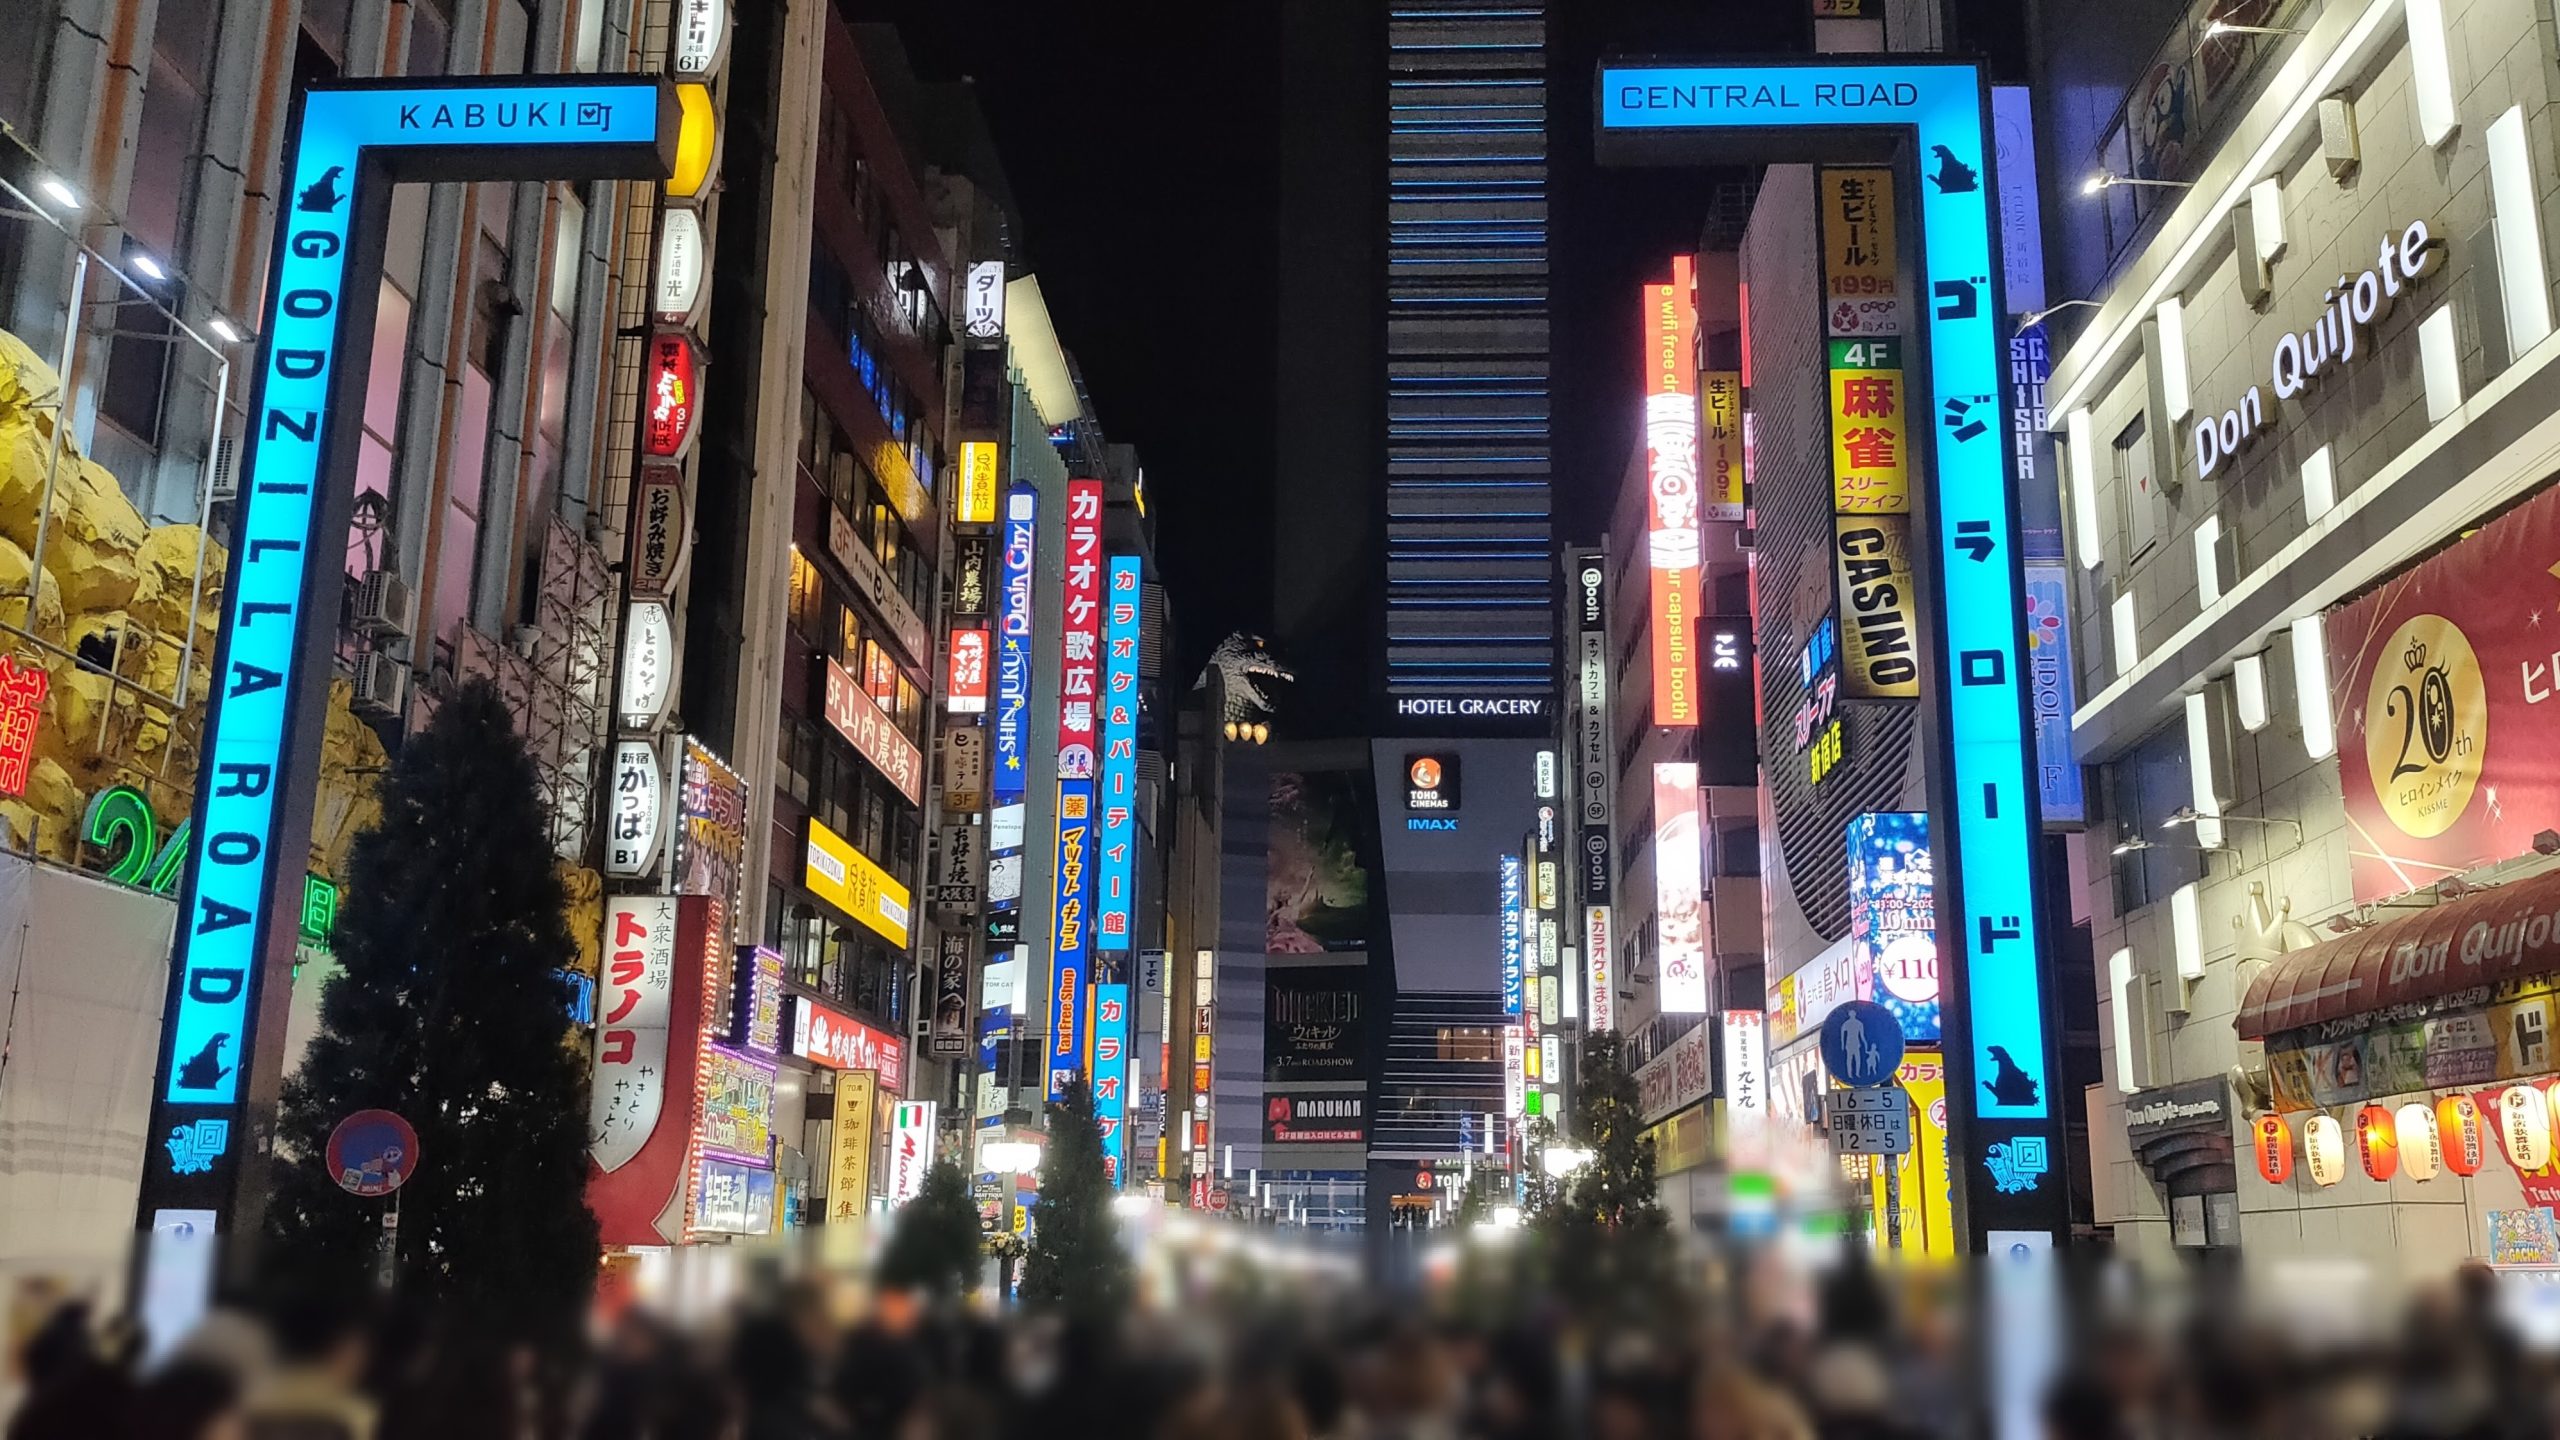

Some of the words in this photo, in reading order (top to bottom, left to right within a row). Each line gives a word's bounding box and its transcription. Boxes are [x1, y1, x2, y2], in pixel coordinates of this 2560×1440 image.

[679, 55, 708, 71] 6F
[400, 101, 613, 132] KABUKI町
[1621, 84, 1800, 110] CENTRAL
[1814, 83, 1918, 107] ROAD
[1839, 178, 1869, 267] 生ビール
[666, 280, 683, 297] 光
[975, 273, 997, 324] ダーツ
[1830, 275, 1895, 295] 199円
[1661, 299, 1677, 331] wifi
[1662, 335, 1680, 370] free
[1843, 342, 1888, 368] 4F
[2195, 384, 2262, 481] Don
[2272, 219, 2429, 400] Quijote
[675, 407, 687, 434] 3F
[1710, 378, 1728, 440] 生ビール
[1841, 376, 1897, 470] 麻雀
[2010, 338, 2035, 480] SHISHA
[229, 229, 341, 699] GODZILLA
[1716, 444, 1729, 498] 199円
[1839, 476, 1889, 491] スリー
[1839, 493, 1906, 510] ファイブ
[645, 487, 669, 577] お好み焼き
[960, 539, 984, 604] 山内農場
[1581, 567, 1602, 622] Booth
[1062, 490, 1099, 733] カラオケ歌広場
[1668, 591, 1684, 664] capsule
[1838, 527, 1917, 687] CASINO
[1934, 276, 2021, 955] ゴジラロード
[635, 628, 656, 709] とらそば
[827, 671, 841, 712] 5F
[1586, 638, 1599, 700] ネットカフェ
[2037, 655, 2062, 725] IDOL
[999, 652, 1024, 754] SHINJUKU
[1398, 699, 1456, 714] HOTEL
[1459, 699, 1542, 715] GRACERY
[1589, 705, 1599, 715] &
[1670, 666, 1687, 720] booth
[627, 714, 649, 728] 1F
[840, 683, 909, 793] 山内農場
[1588, 719, 1601, 764] カプセル
[620, 752, 650, 764] 新宿
[1103, 570, 1136, 934] カラオケ&パーティー館
[1810, 719, 1842, 786] 新宿店
[953, 793, 973, 807] 3F
[1410, 790, 1438, 800] TOHO
[1541, 760, 1550, 794] 東京ビル
[2043, 765, 2062, 790] F
[2399, 769, 2463, 807] ヒロインメイク
[614, 766, 648, 840] かっぱ
[1065, 797, 1084, 817] 薬
[1407, 818, 1457, 830] IMAX
[1410, 799, 1448, 808] CINEMAS
[2418, 798, 2449, 818] KISSME
[615, 850, 639, 864] B1
[1586, 834, 1607, 892] Booth
[189, 761, 272, 1005] ROAD
[1059, 826, 1087, 950] マツモトキヨシ
[648, 902, 673, 991] 大衆酒場
[942, 935, 965, 990] 海の家
[1504, 911, 1519, 1009] カラオケランド
[1592, 921, 1607, 973] カラオケ
[2389, 939, 2449, 985] Don
[601, 912, 648, 1065] トラノコ
[1060, 969, 1075, 1003] Shop
[1823, 957, 1850, 1004] 鳥メロ
[1058, 1004, 1073, 1031] Free
[2515, 1008, 2544, 1066] ド
[1057, 1033, 1073, 1055] Tax
[1276, 1056, 1292, 1067] 3.7
[1302, 1058, 1354, 1067] ROADSHOW
[1738, 1070, 1756, 1109] 九十九
[1900, 1063, 1945, 1082] カラ
[598, 1078, 630, 1145] やきとん
[624, 1065, 654, 1131] やきとり
[1296, 1099, 1361, 1118] MARUHAN
[2125, 1109, 2145, 1126] Don
[2144, 1100, 2179, 1126] Quijote
[840, 1118, 860, 1192] 珈琲茶館
[2266, 1136, 2282, 1175] 新宿歌舞伎町
[2463, 1119, 2478, 1166] 新宿歌舞伎町
[2511, 1111, 2531, 1161] 新宿歌舞伎町
[897, 1131, 917, 1199] Miami
[2529, 1187, 2550, 1202] Tax
[2508, 1246, 2541, 1263] GACHA
